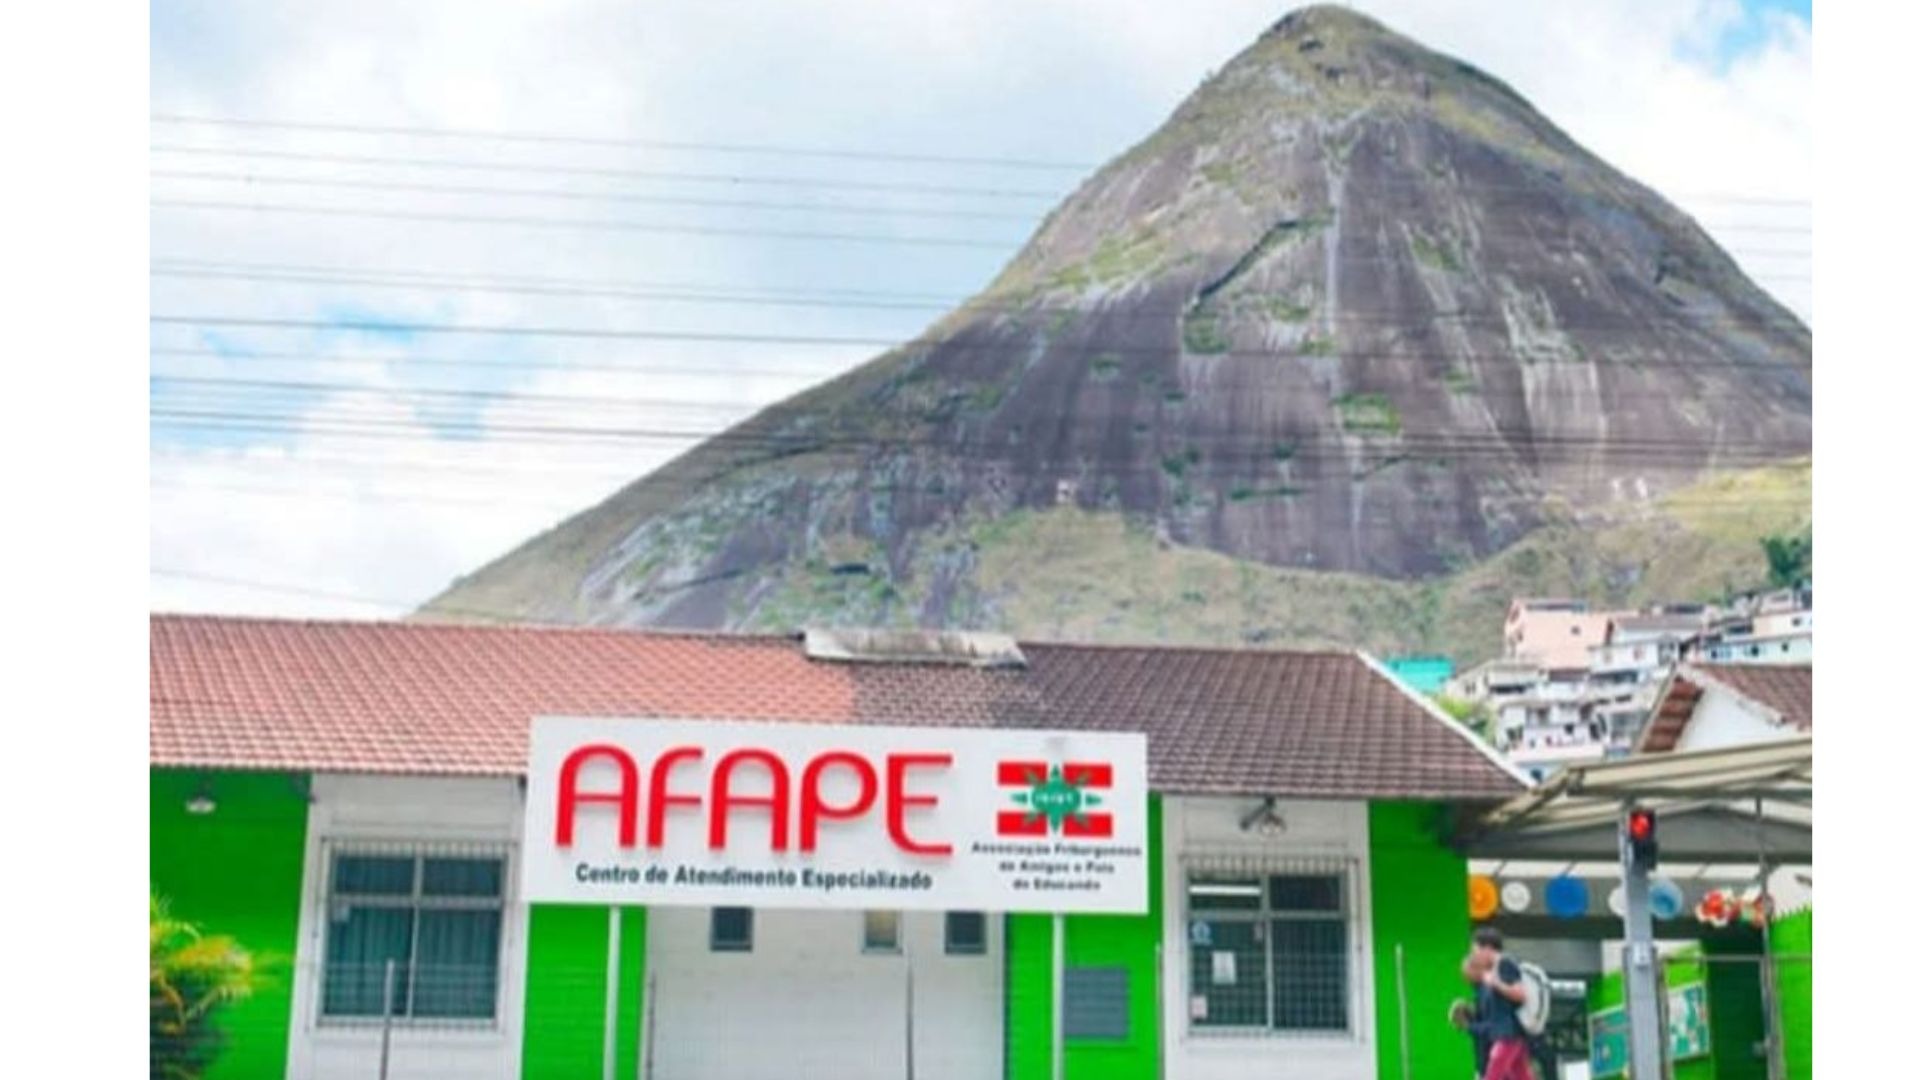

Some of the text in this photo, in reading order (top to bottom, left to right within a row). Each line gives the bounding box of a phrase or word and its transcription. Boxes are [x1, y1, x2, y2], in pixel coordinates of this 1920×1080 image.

[555, 745, 953, 856] AFAPE
[575, 863, 933, 892] Centro de Atendimento Especializado
